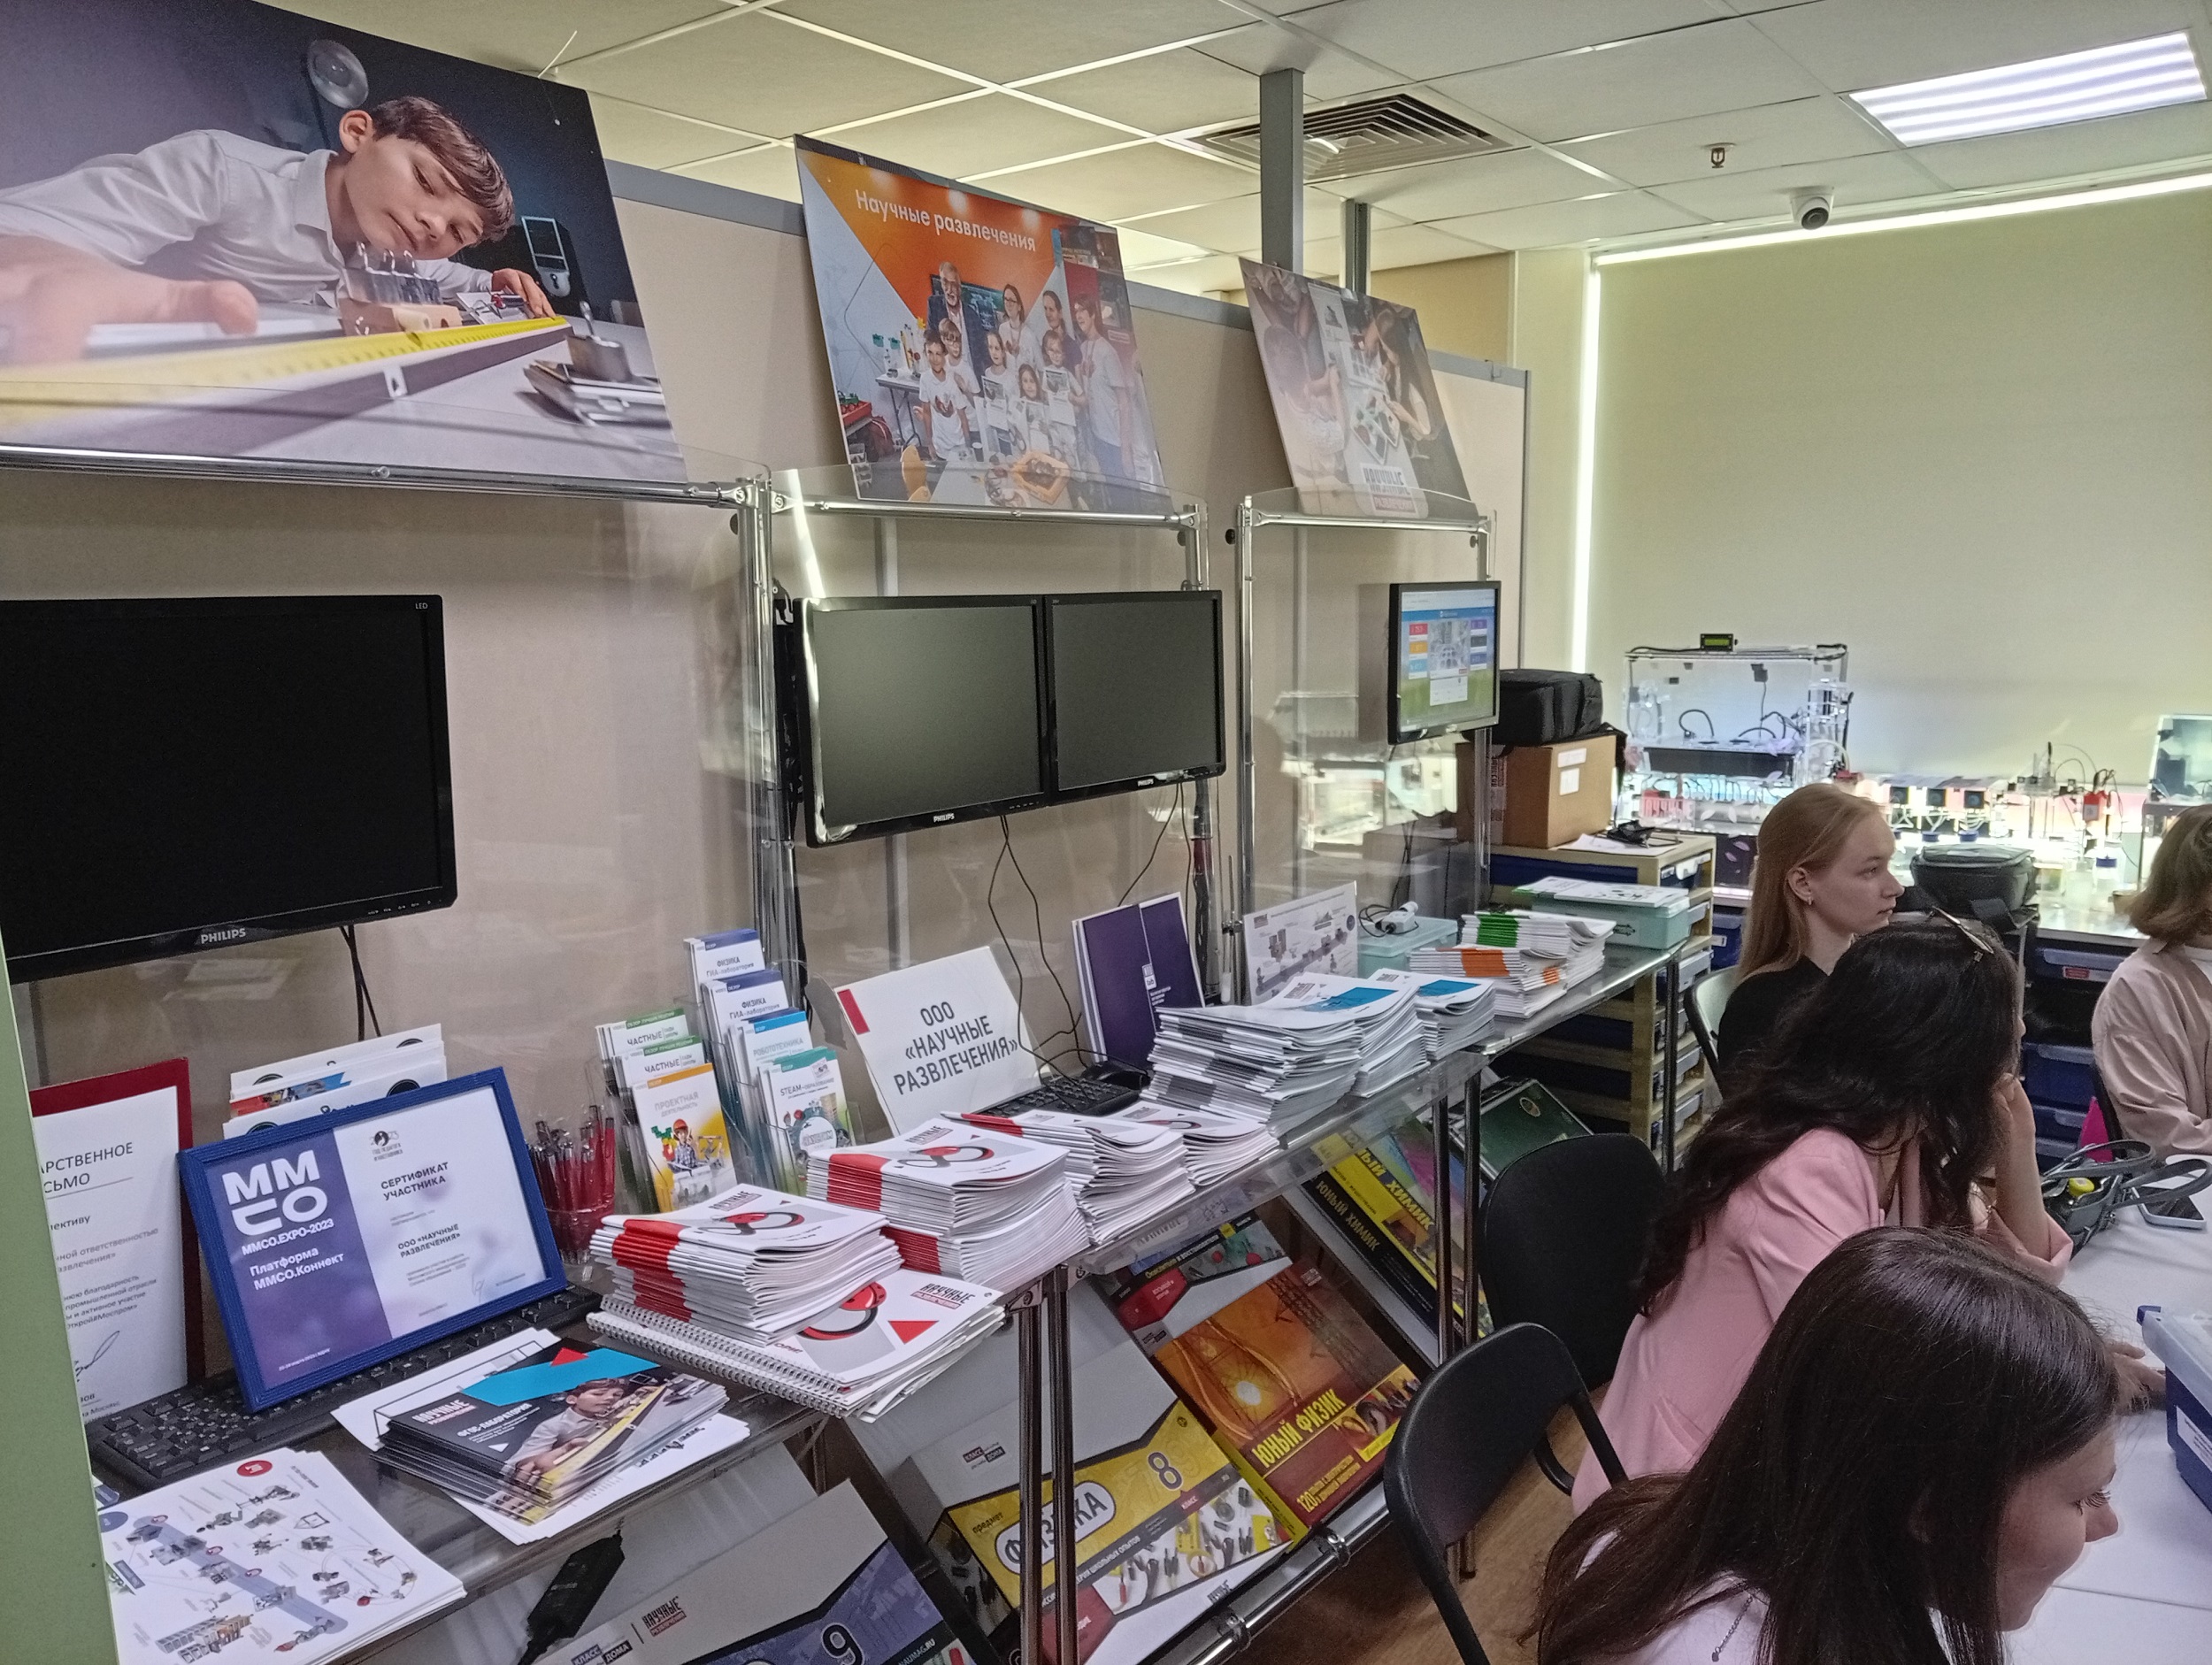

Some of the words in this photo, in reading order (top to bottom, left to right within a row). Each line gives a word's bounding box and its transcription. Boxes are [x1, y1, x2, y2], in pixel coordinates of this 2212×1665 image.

[856, 189, 930, 226] Научные
[934, 213, 1036, 251] развлечения
[201, 928, 247, 944] PHILIPS
[717, 956, 741, 967] ФИЗИКА
[741, 998, 766, 1009] ФИЗИКА
[920, 1001, 955, 1026] ООО
[626, 1031, 663, 1046] ЧАСТНЫЕ
[753, 1038, 804, 1056] РОБОТОТЕХНИКА
[905, 1016, 993, 1059] «НАУЧНЫЕ
[644, 1058, 680, 1073] ЧАСТНЫЕ
[894, 1037, 1018, 1095] РАЗВЛЕЧЕНИЯ»
[655, 1092, 699, 1111] ПРОЕКТНАЯ
[380, 1162, 449, 1190] СЕРТИФИКАТ
[383, 1175, 446, 1201] УЧАСТНИКА
[1315, 1180, 1349, 1216] ЮНЫЙ
[1345, 1212, 1382, 1252] ХИМИК
[1386, 1178, 1436, 1231] ХИМИК
[80, 1228, 158, 1255] ответственностью
[398, 1239, 417, 1250] ООО
[417, 1224, 459, 1243] «НАУЧНЫЕ
[401, 1232, 461, 1258] РАЗВЛЕЧЕНИЯ»
[250, 1247, 319, 1277] Платформа
[65, 1288, 127, 1311] промышленной
[128, 1279, 157, 1293] отрасли
[84, 1275, 140, 1296] благодарность
[920, 1283, 976, 1304] НАУЧНЫЕ
[81, 1301, 117, 1316] активное
[118, 1292, 146, 1305] участие
[1251, 1418, 1303, 1469] ЮНЫЙ
[1295, 1388, 1347, 1433] ФИЗИК
[1147, 1451, 1184, 1491] 8
[1296, 1491, 1318, 1513] 120
[972, 1511, 1004, 1535] предмет
[1004, 1492, 1109, 1564] ФЗКА
[641, 1595, 682, 1629] НАУЧНЫЕ
[573, 1646, 601, 1665] КЛАСС
[604, 1643, 630, 1663] ДОМА
[821, 1622, 865, 1665] 9
